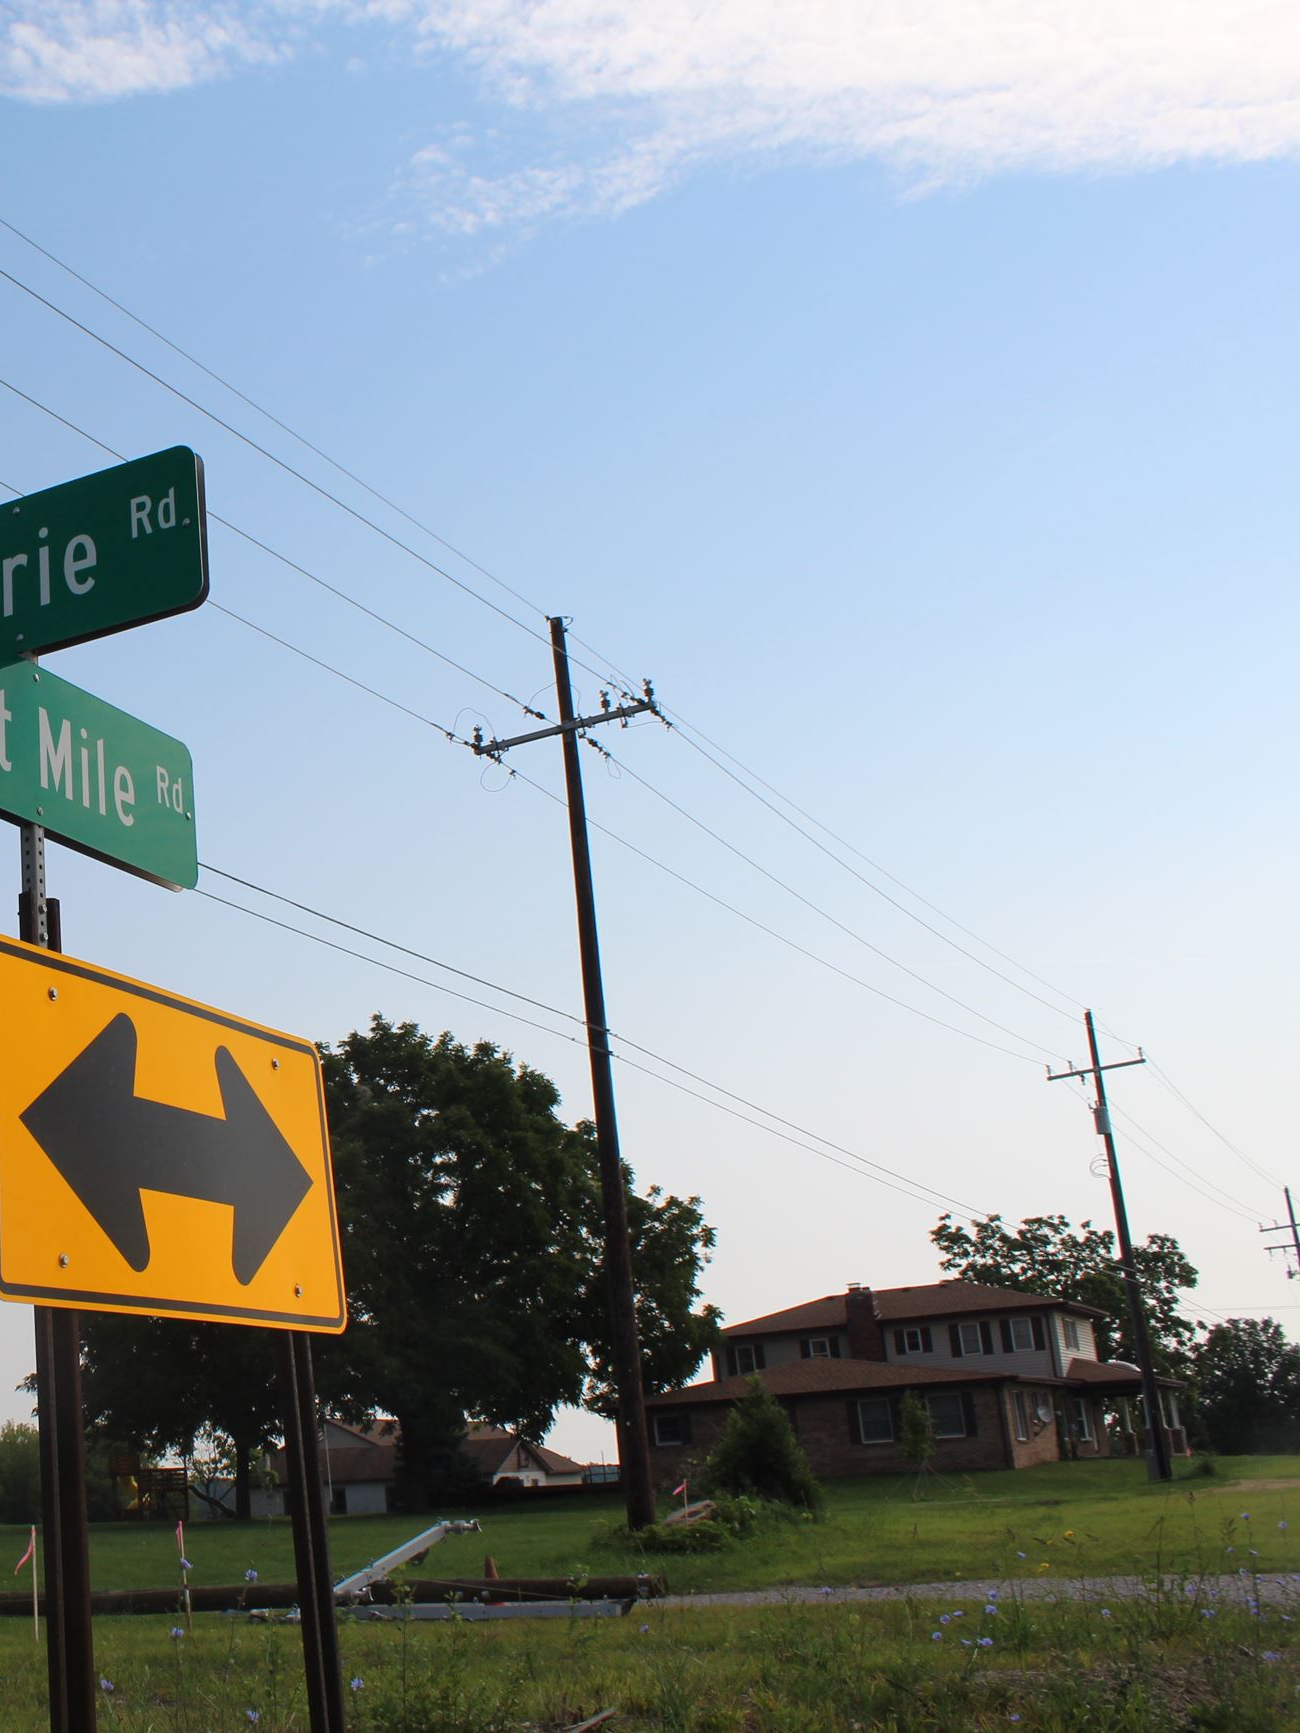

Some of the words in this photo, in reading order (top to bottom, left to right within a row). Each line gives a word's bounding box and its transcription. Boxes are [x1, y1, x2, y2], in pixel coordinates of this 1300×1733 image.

[130, 486, 177, 539] Rd
[38, 706, 136, 827] Mile
[156, 765, 184, 814] Rd
